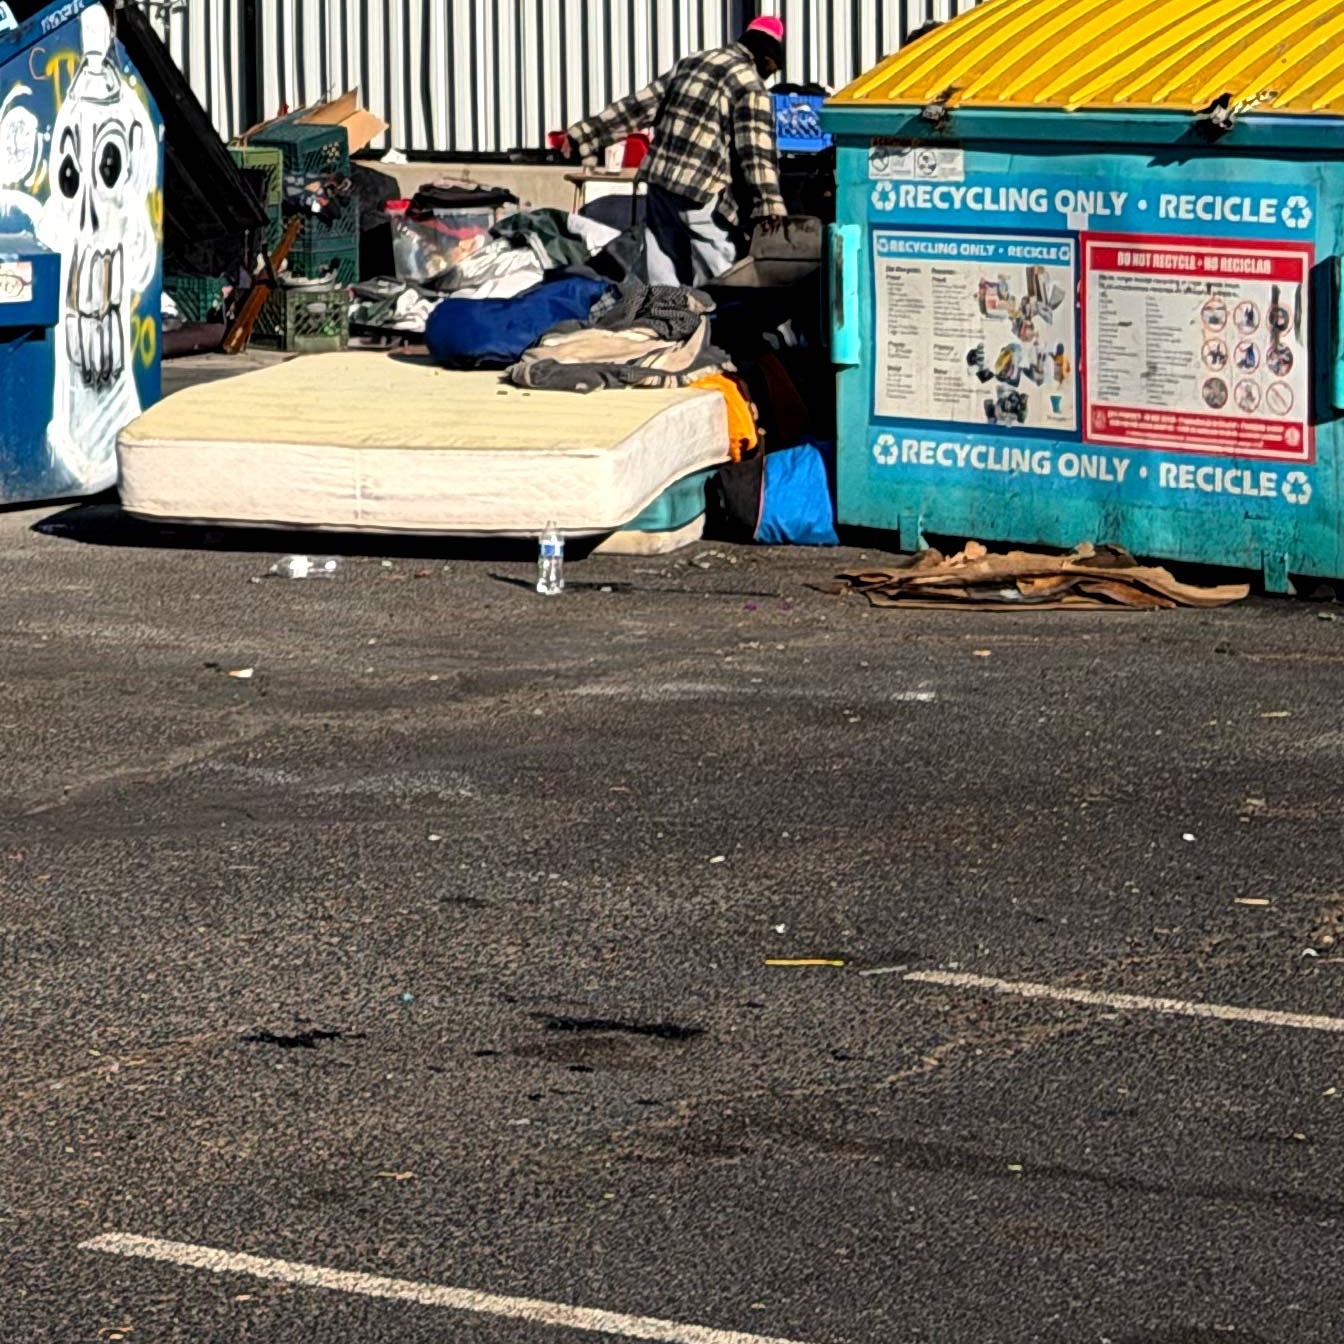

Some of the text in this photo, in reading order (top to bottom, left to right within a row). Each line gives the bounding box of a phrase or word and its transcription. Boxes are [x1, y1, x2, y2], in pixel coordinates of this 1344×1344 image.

[899, 184, 1278, 223] RECYCLING ONLY RECICLE
[889, 239, 1057, 261] RECYCLING ONLY RECICLE
[902, 439, 1278, 498] RECYCLING ONLY RECICLE
